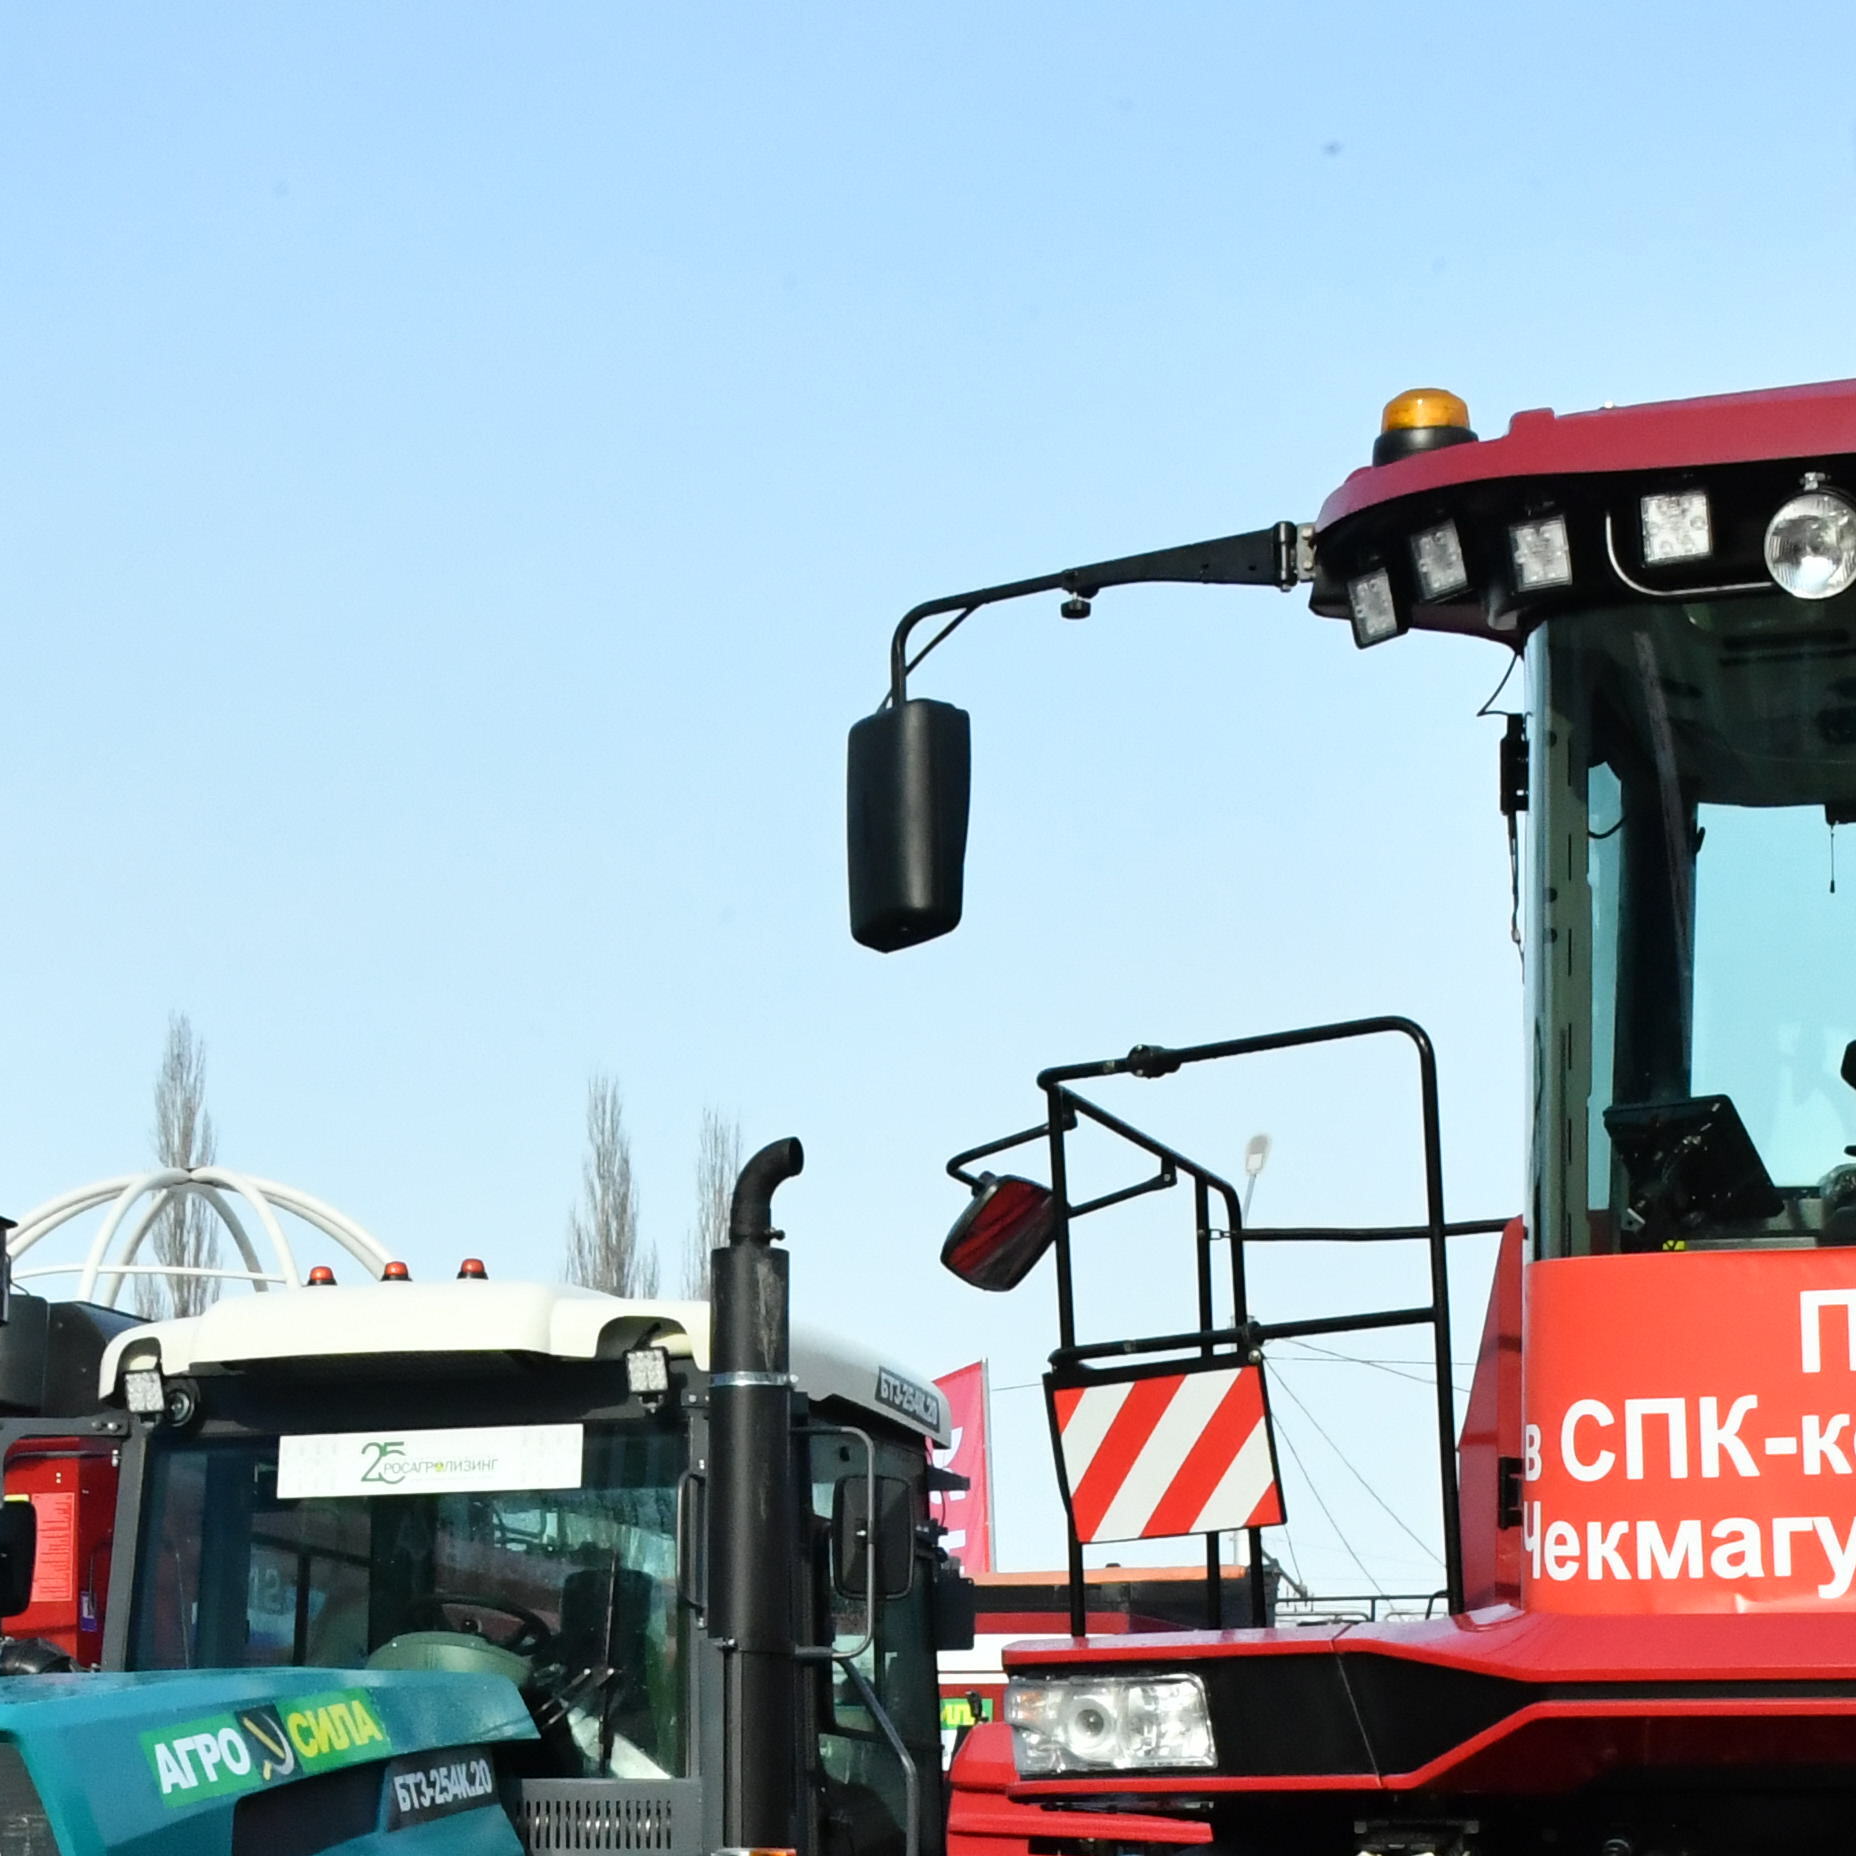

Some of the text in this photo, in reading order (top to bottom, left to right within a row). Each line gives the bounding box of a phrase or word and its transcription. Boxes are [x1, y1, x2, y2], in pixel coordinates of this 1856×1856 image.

[1524, 1423, 1543, 1482] в
[153, 1699, 384, 1795] АГРО СИЛА
